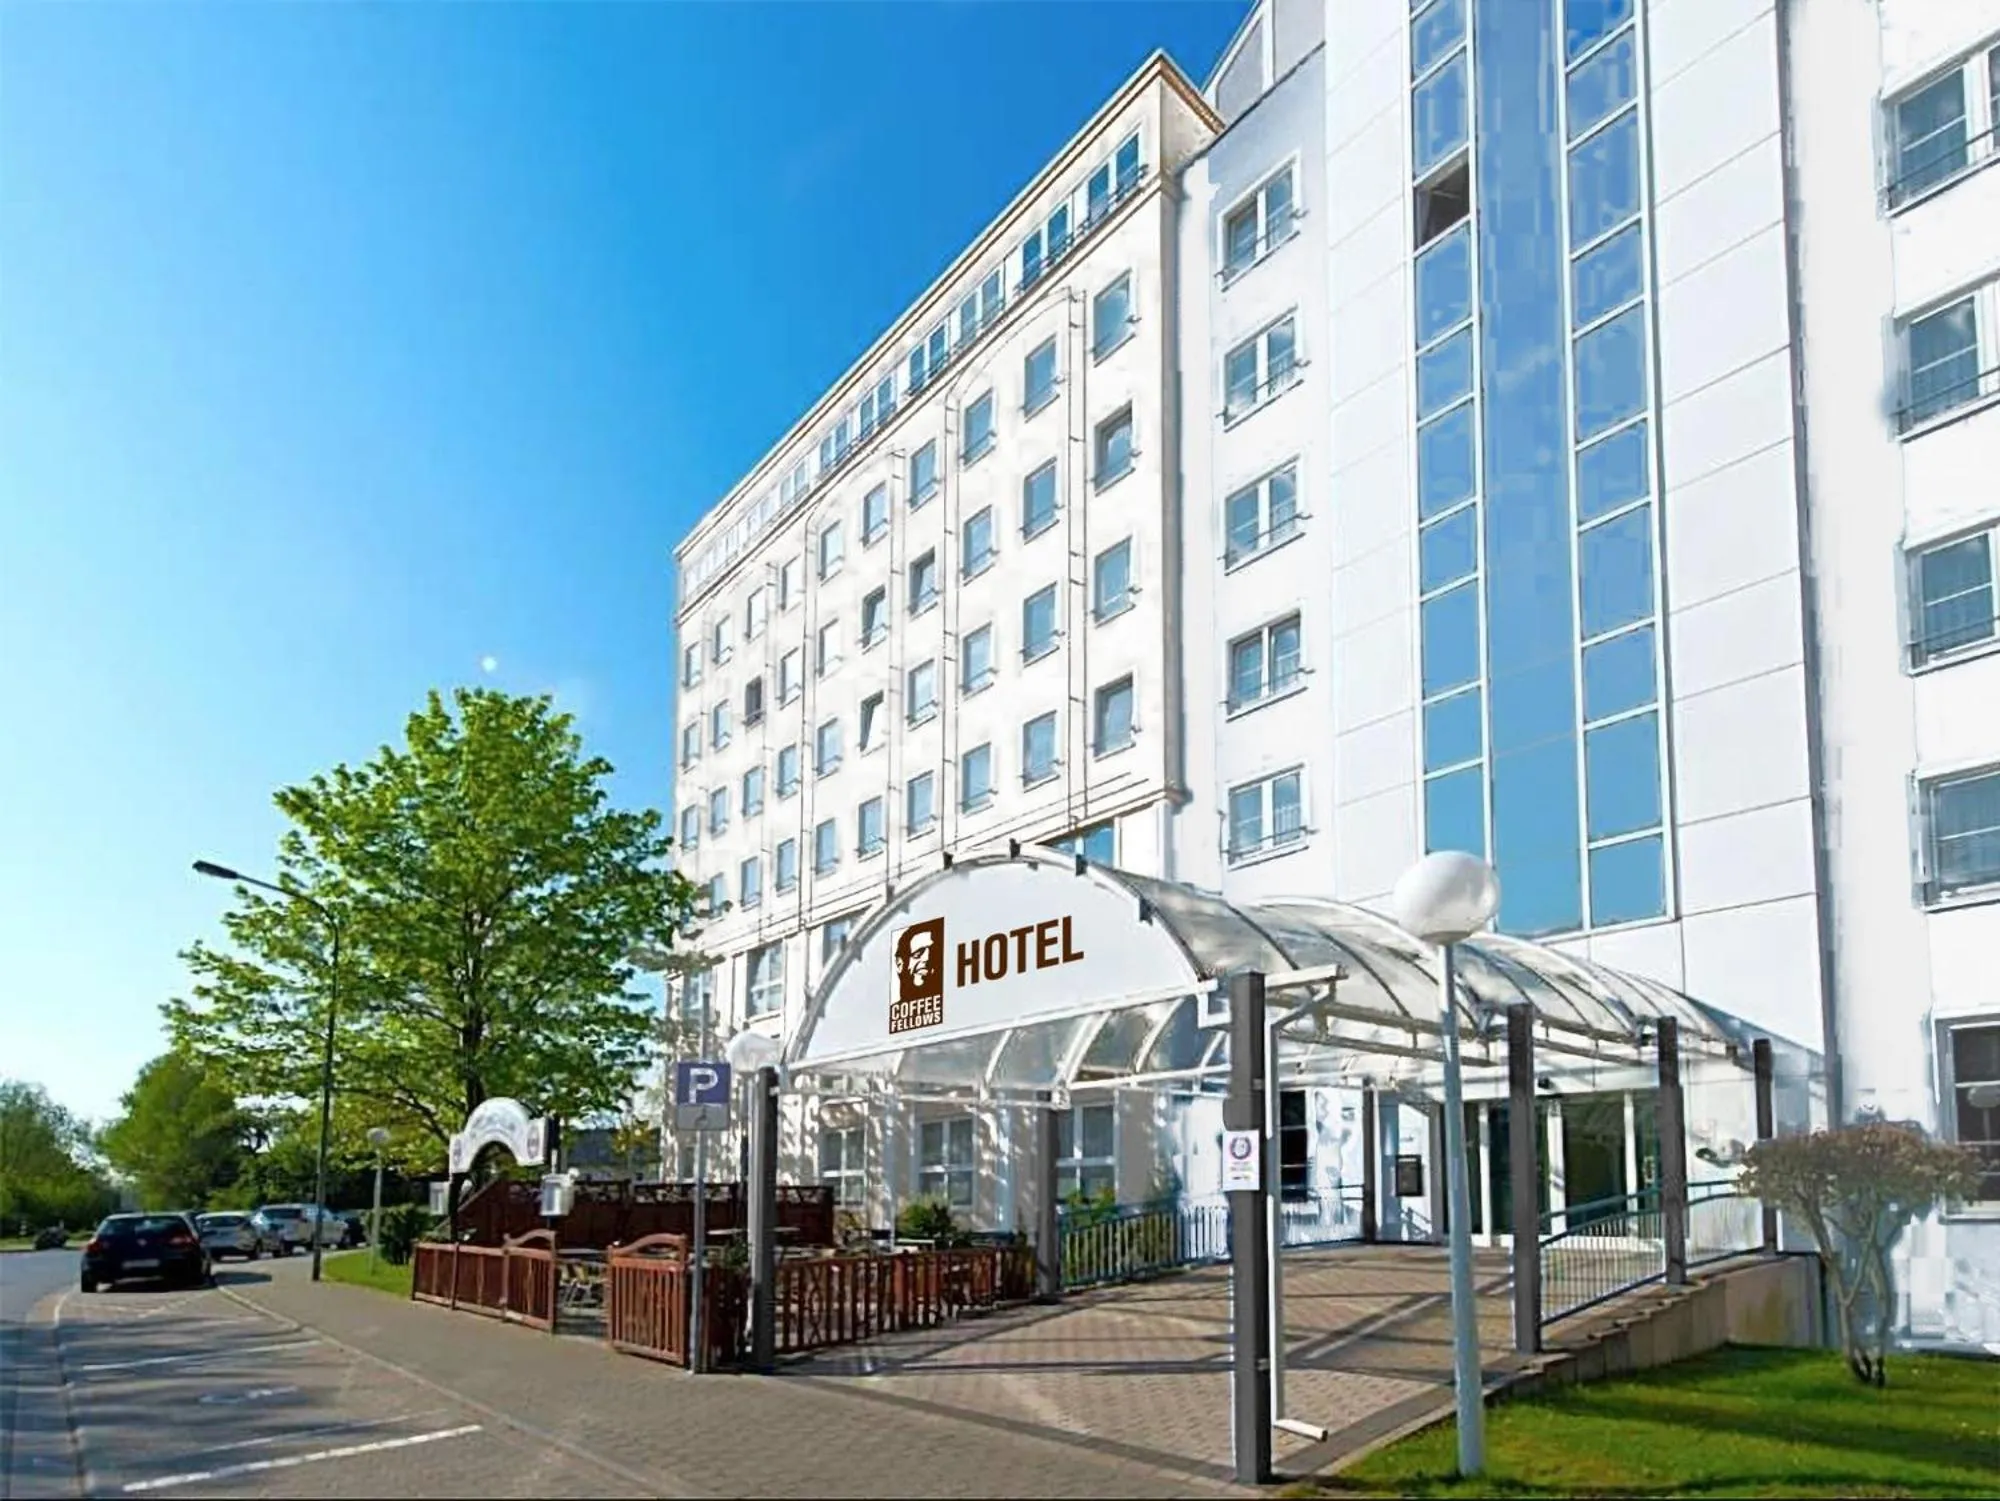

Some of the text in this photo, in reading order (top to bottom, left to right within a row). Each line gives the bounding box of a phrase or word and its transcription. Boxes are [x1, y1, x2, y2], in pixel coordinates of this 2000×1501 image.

[957, 915, 1084, 988] HOTEL
[891, 995, 941, 1021] COFFEE
[891, 1011, 941, 1033] FELLOWS
[688, 1067, 719, 1104] P
